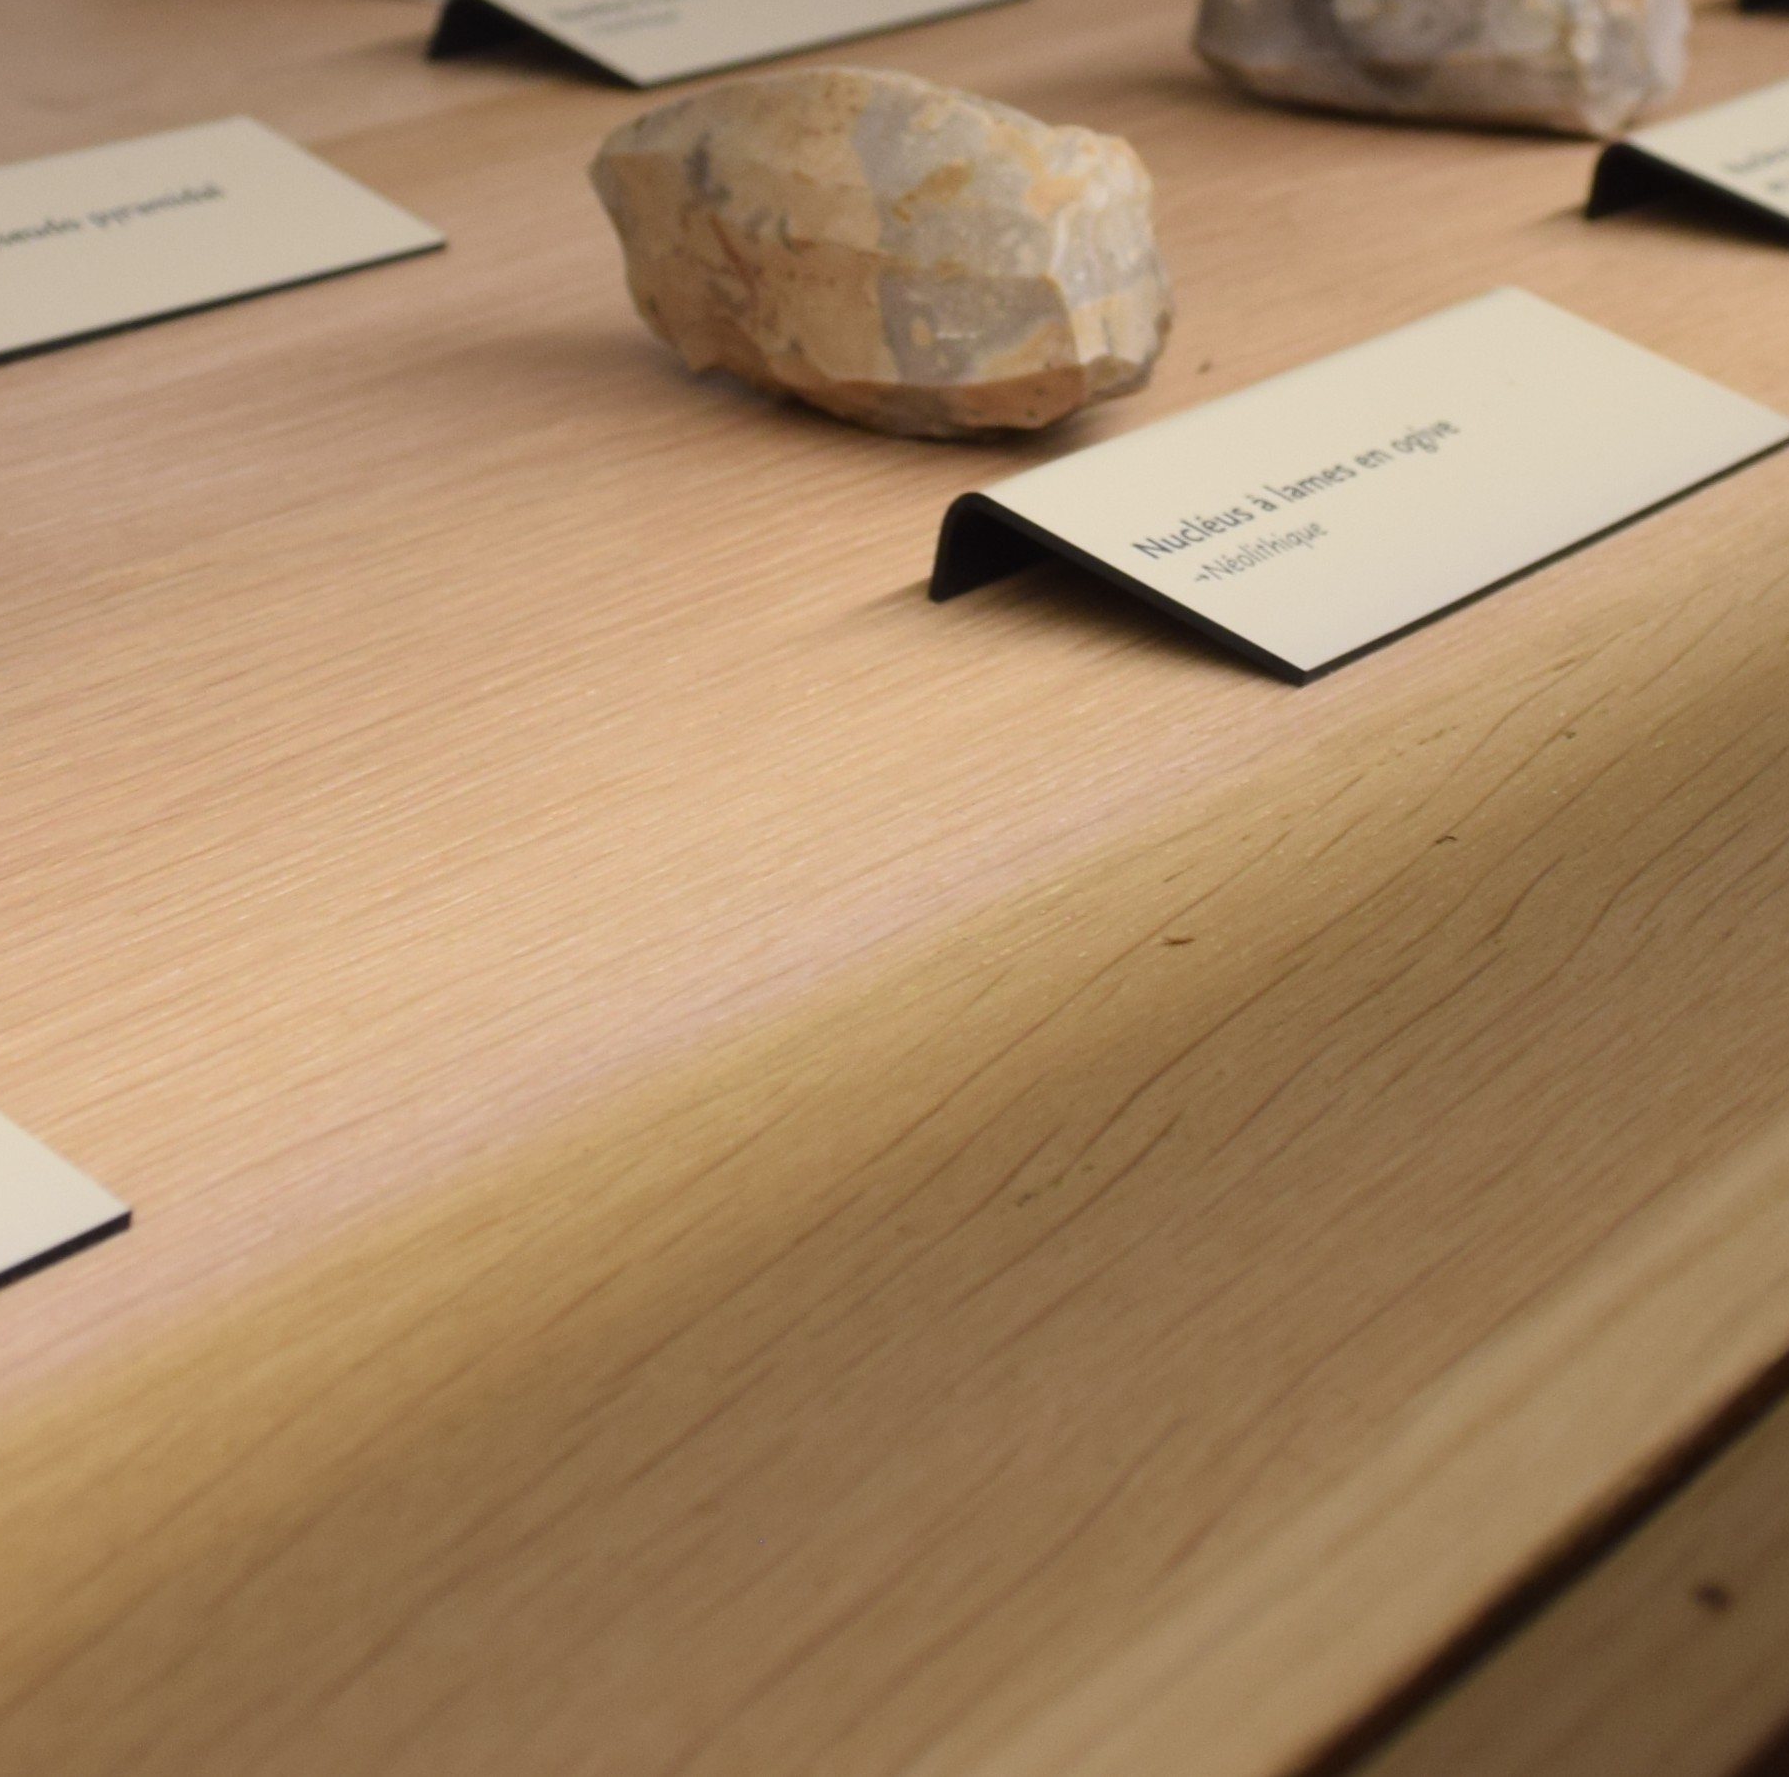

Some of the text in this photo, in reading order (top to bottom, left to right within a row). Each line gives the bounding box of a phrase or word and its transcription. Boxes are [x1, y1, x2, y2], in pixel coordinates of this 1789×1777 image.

[1132, 419, 1460, 560] Nucléus à lames en ogive
[1200, 521, 1328, 581] Néolithique
